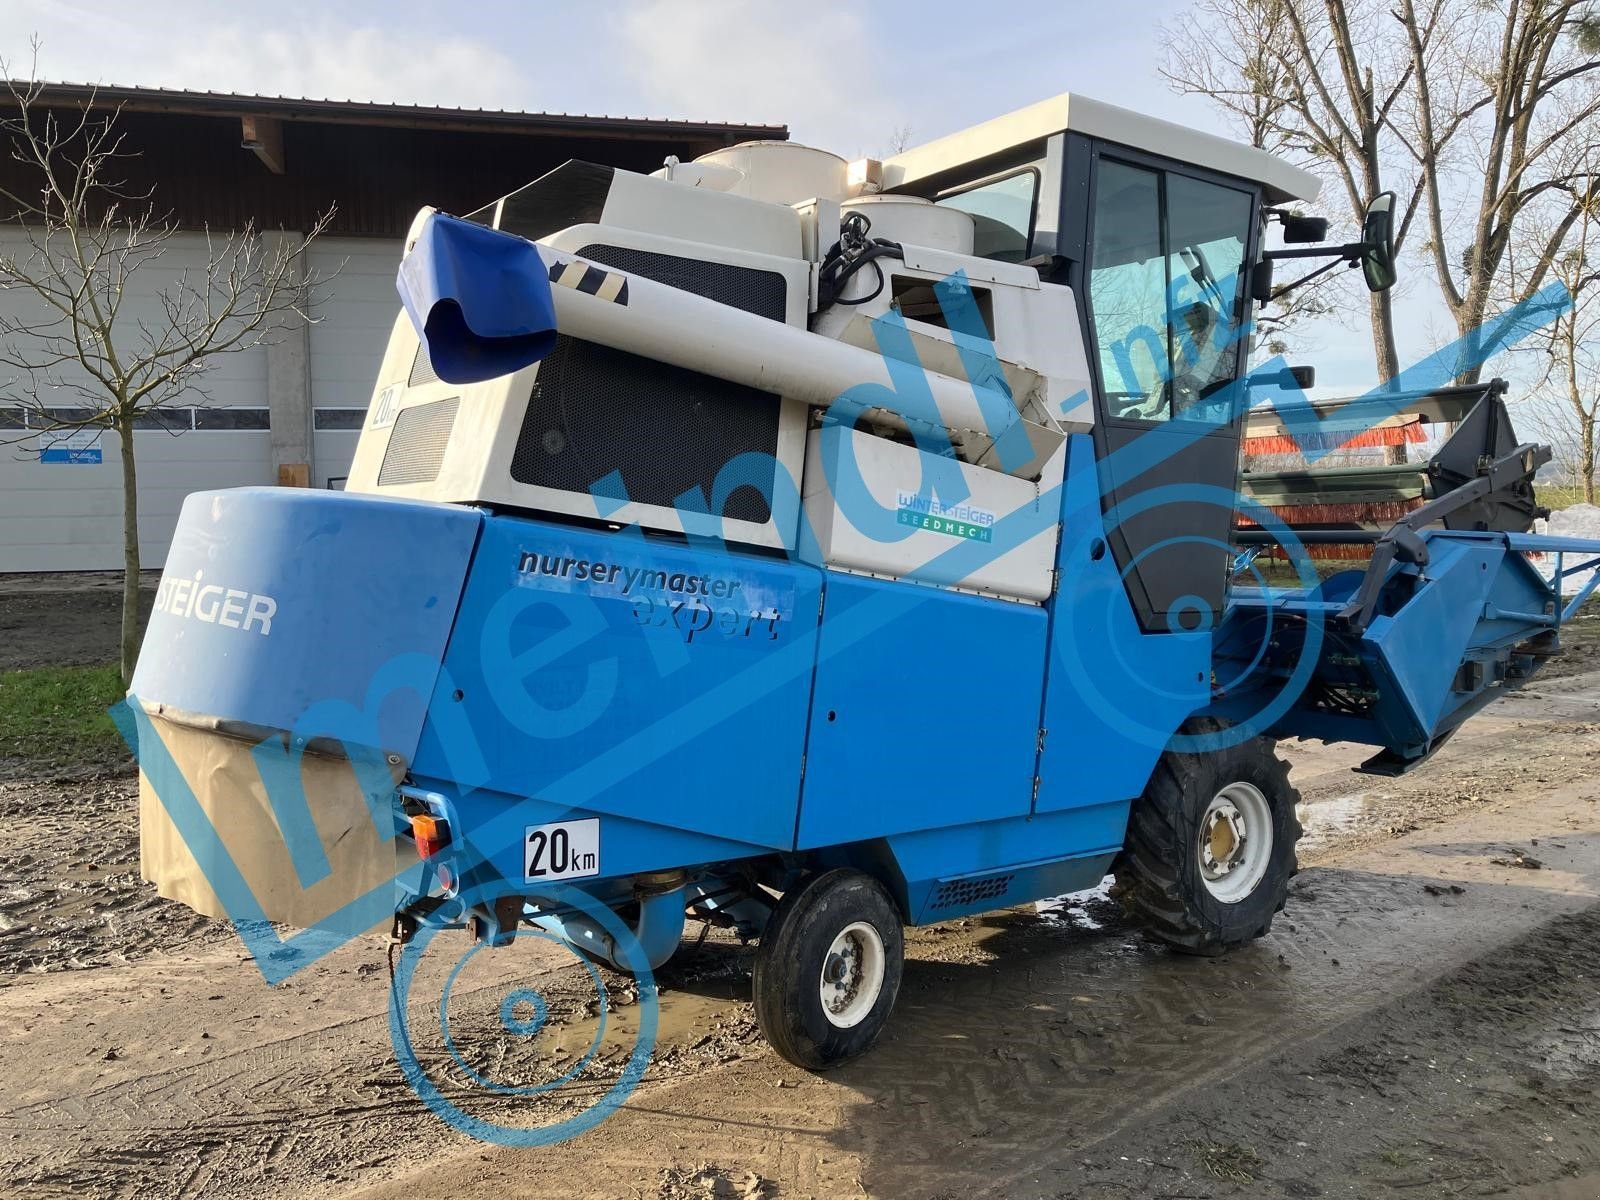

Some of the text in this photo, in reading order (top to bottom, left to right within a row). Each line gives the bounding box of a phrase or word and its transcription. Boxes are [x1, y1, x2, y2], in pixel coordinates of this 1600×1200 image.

[901, 512, 988, 540] SEEDMECH
[518, 551, 741, 600] nurserymaster
[631, 594, 782, 643] expert
